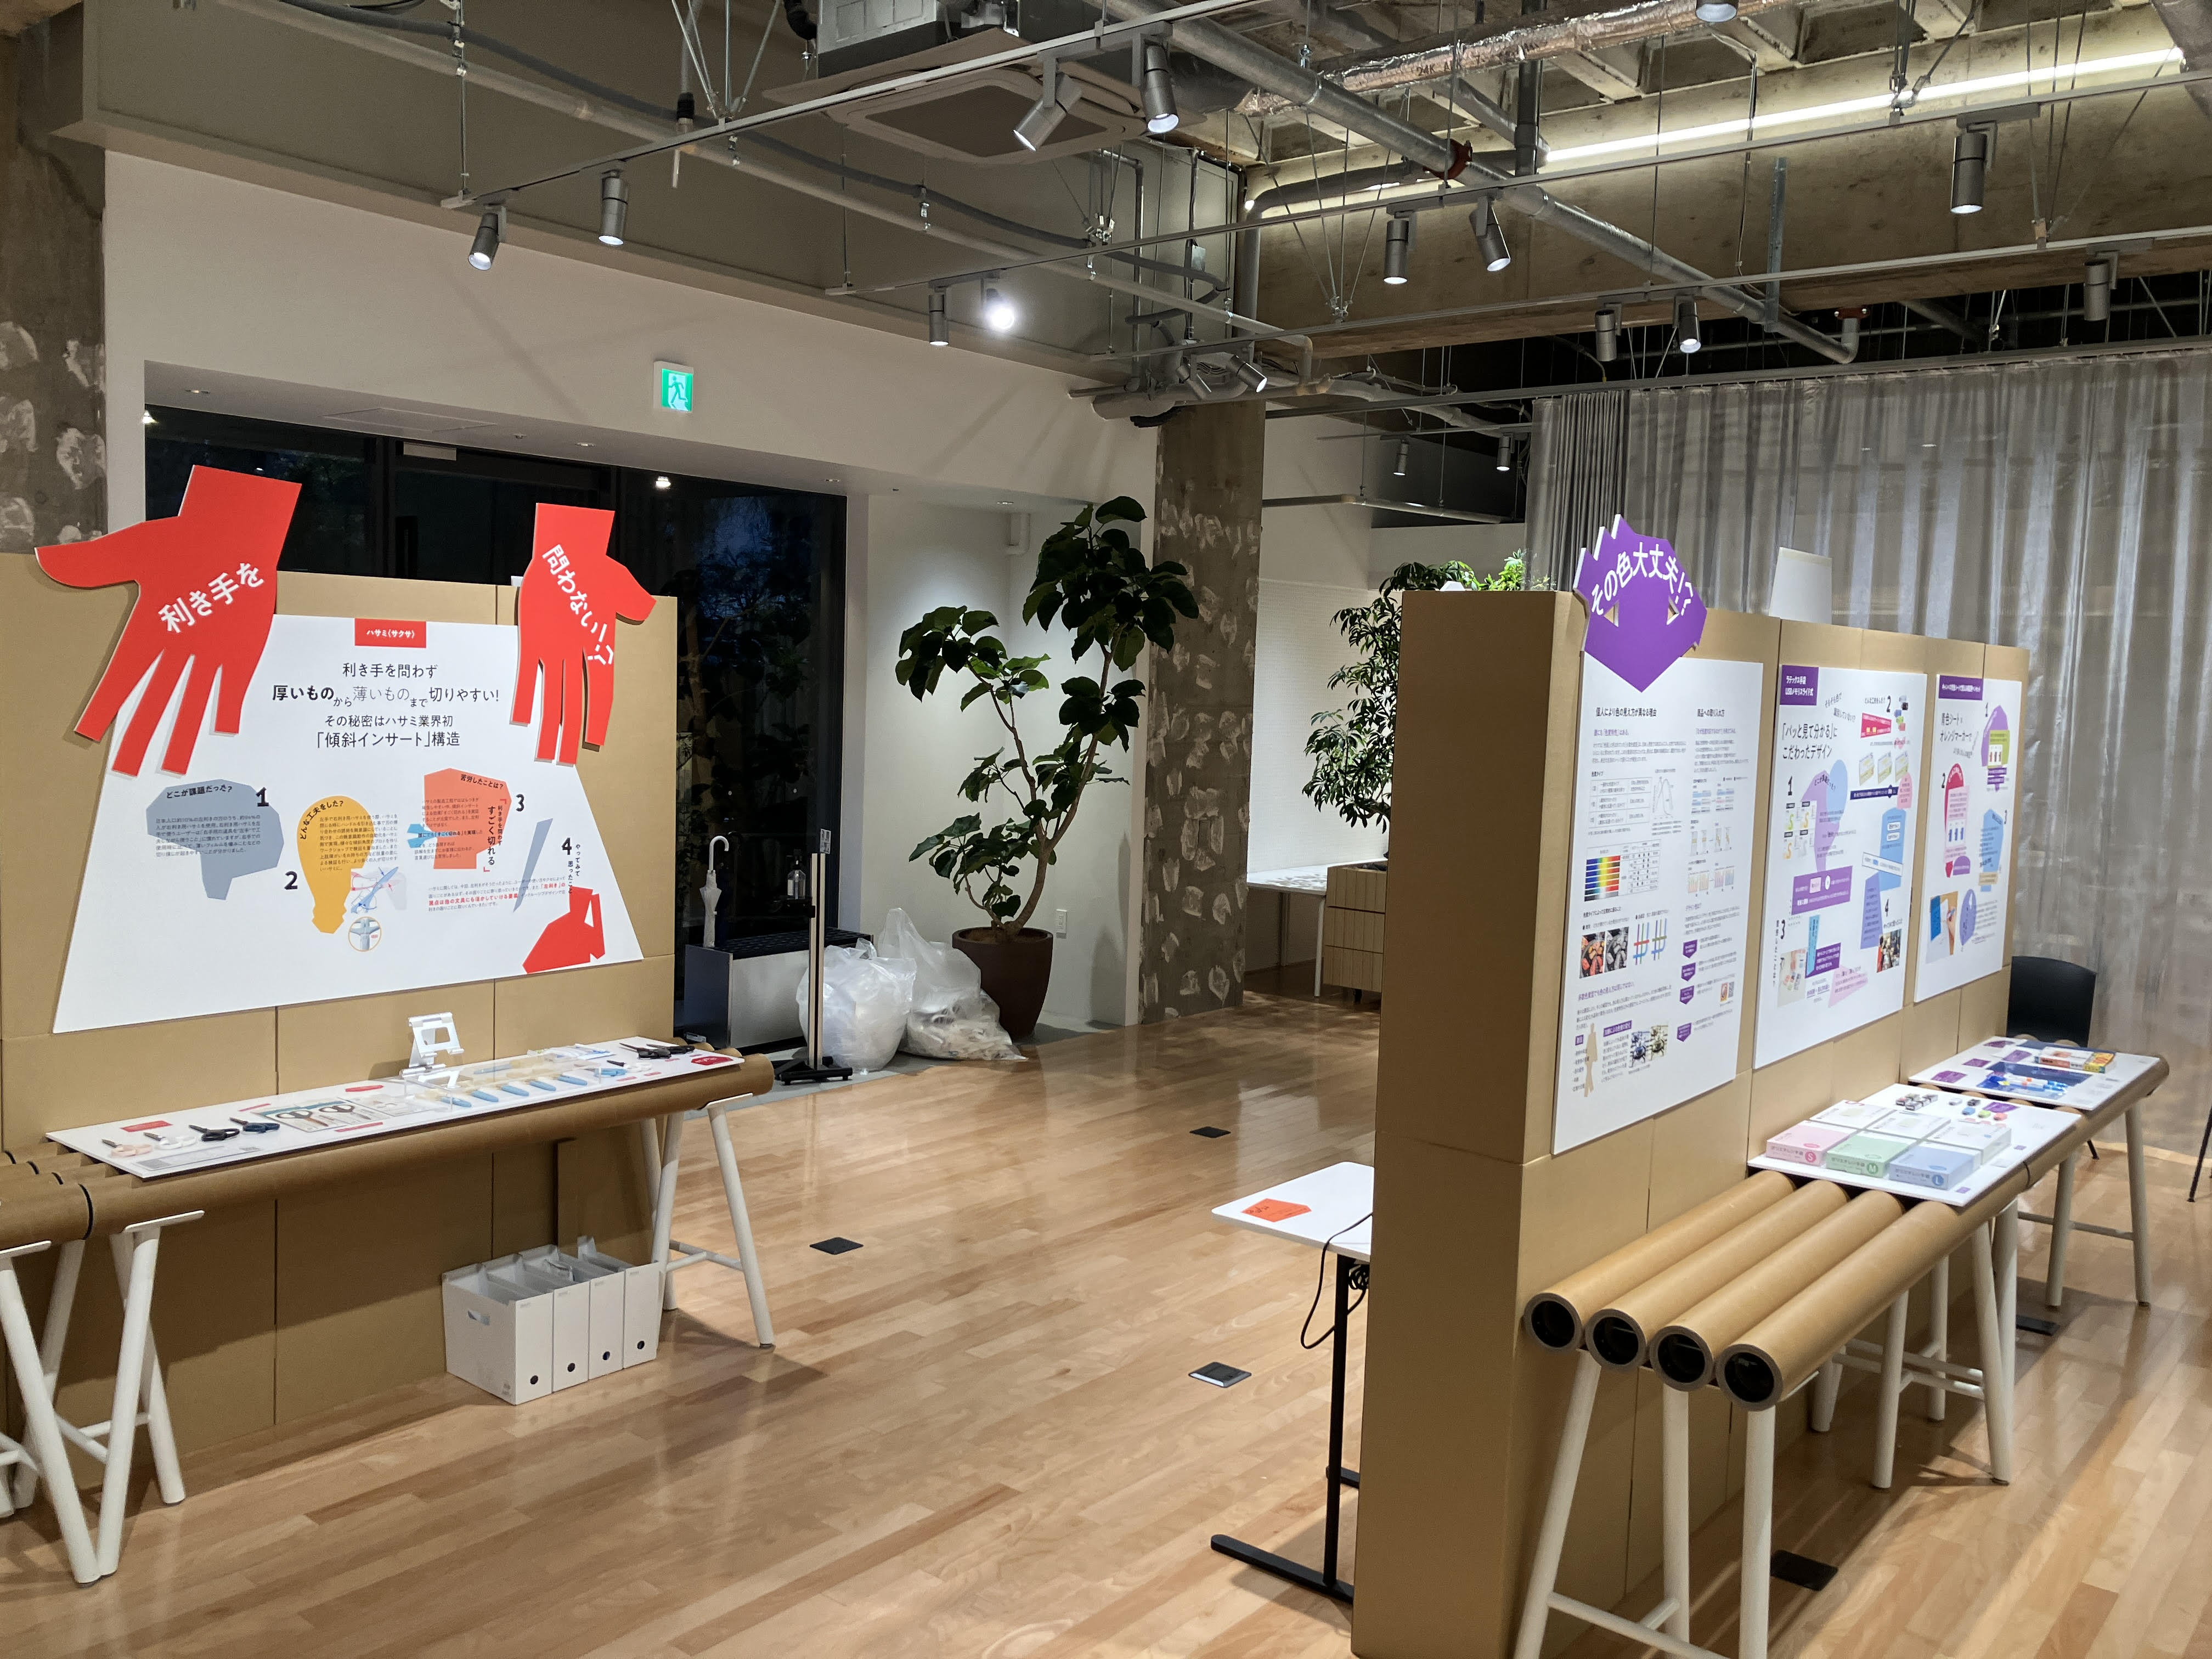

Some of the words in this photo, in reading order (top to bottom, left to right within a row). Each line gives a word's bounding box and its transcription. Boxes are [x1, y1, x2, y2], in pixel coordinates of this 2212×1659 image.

[1591, 541, 1694, 616] その色大丈夫!?
[157, 562, 265, 633] 利き手を
[342, 662, 438, 678] 利き手を問わず
[1886, 695, 1892, 713] 2
[325, 714, 454, 727] その秘密はハサミ業界初
[317, 730, 460, 748] 「傾斜インサート」構造
[1782, 723, 1838, 741] 「パッと見て分かる」に
[1782, 743, 1832, 760] こだわったデザイン
[460, 774, 504, 790] 苦労したことは?
[1787, 775, 1793, 796] 1
[1942, 772, 1946, 788] 2
[166, 784, 233, 799] どこが課題だった?
[256, 787, 269, 807] 1
[516, 794, 524, 812] 3
[300, 800, 344, 840] どんな工夫をした?
[561, 837, 572, 855] 4
[284, 870, 298, 890] 2
[1885, 899, 1889, 917] 4
[1780, 919, 1786, 940] 3
[1807, 1152, 1813, 1161] S
[1869, 1164, 1877, 1173] M
[1935, 1176, 1940, 1185] L
